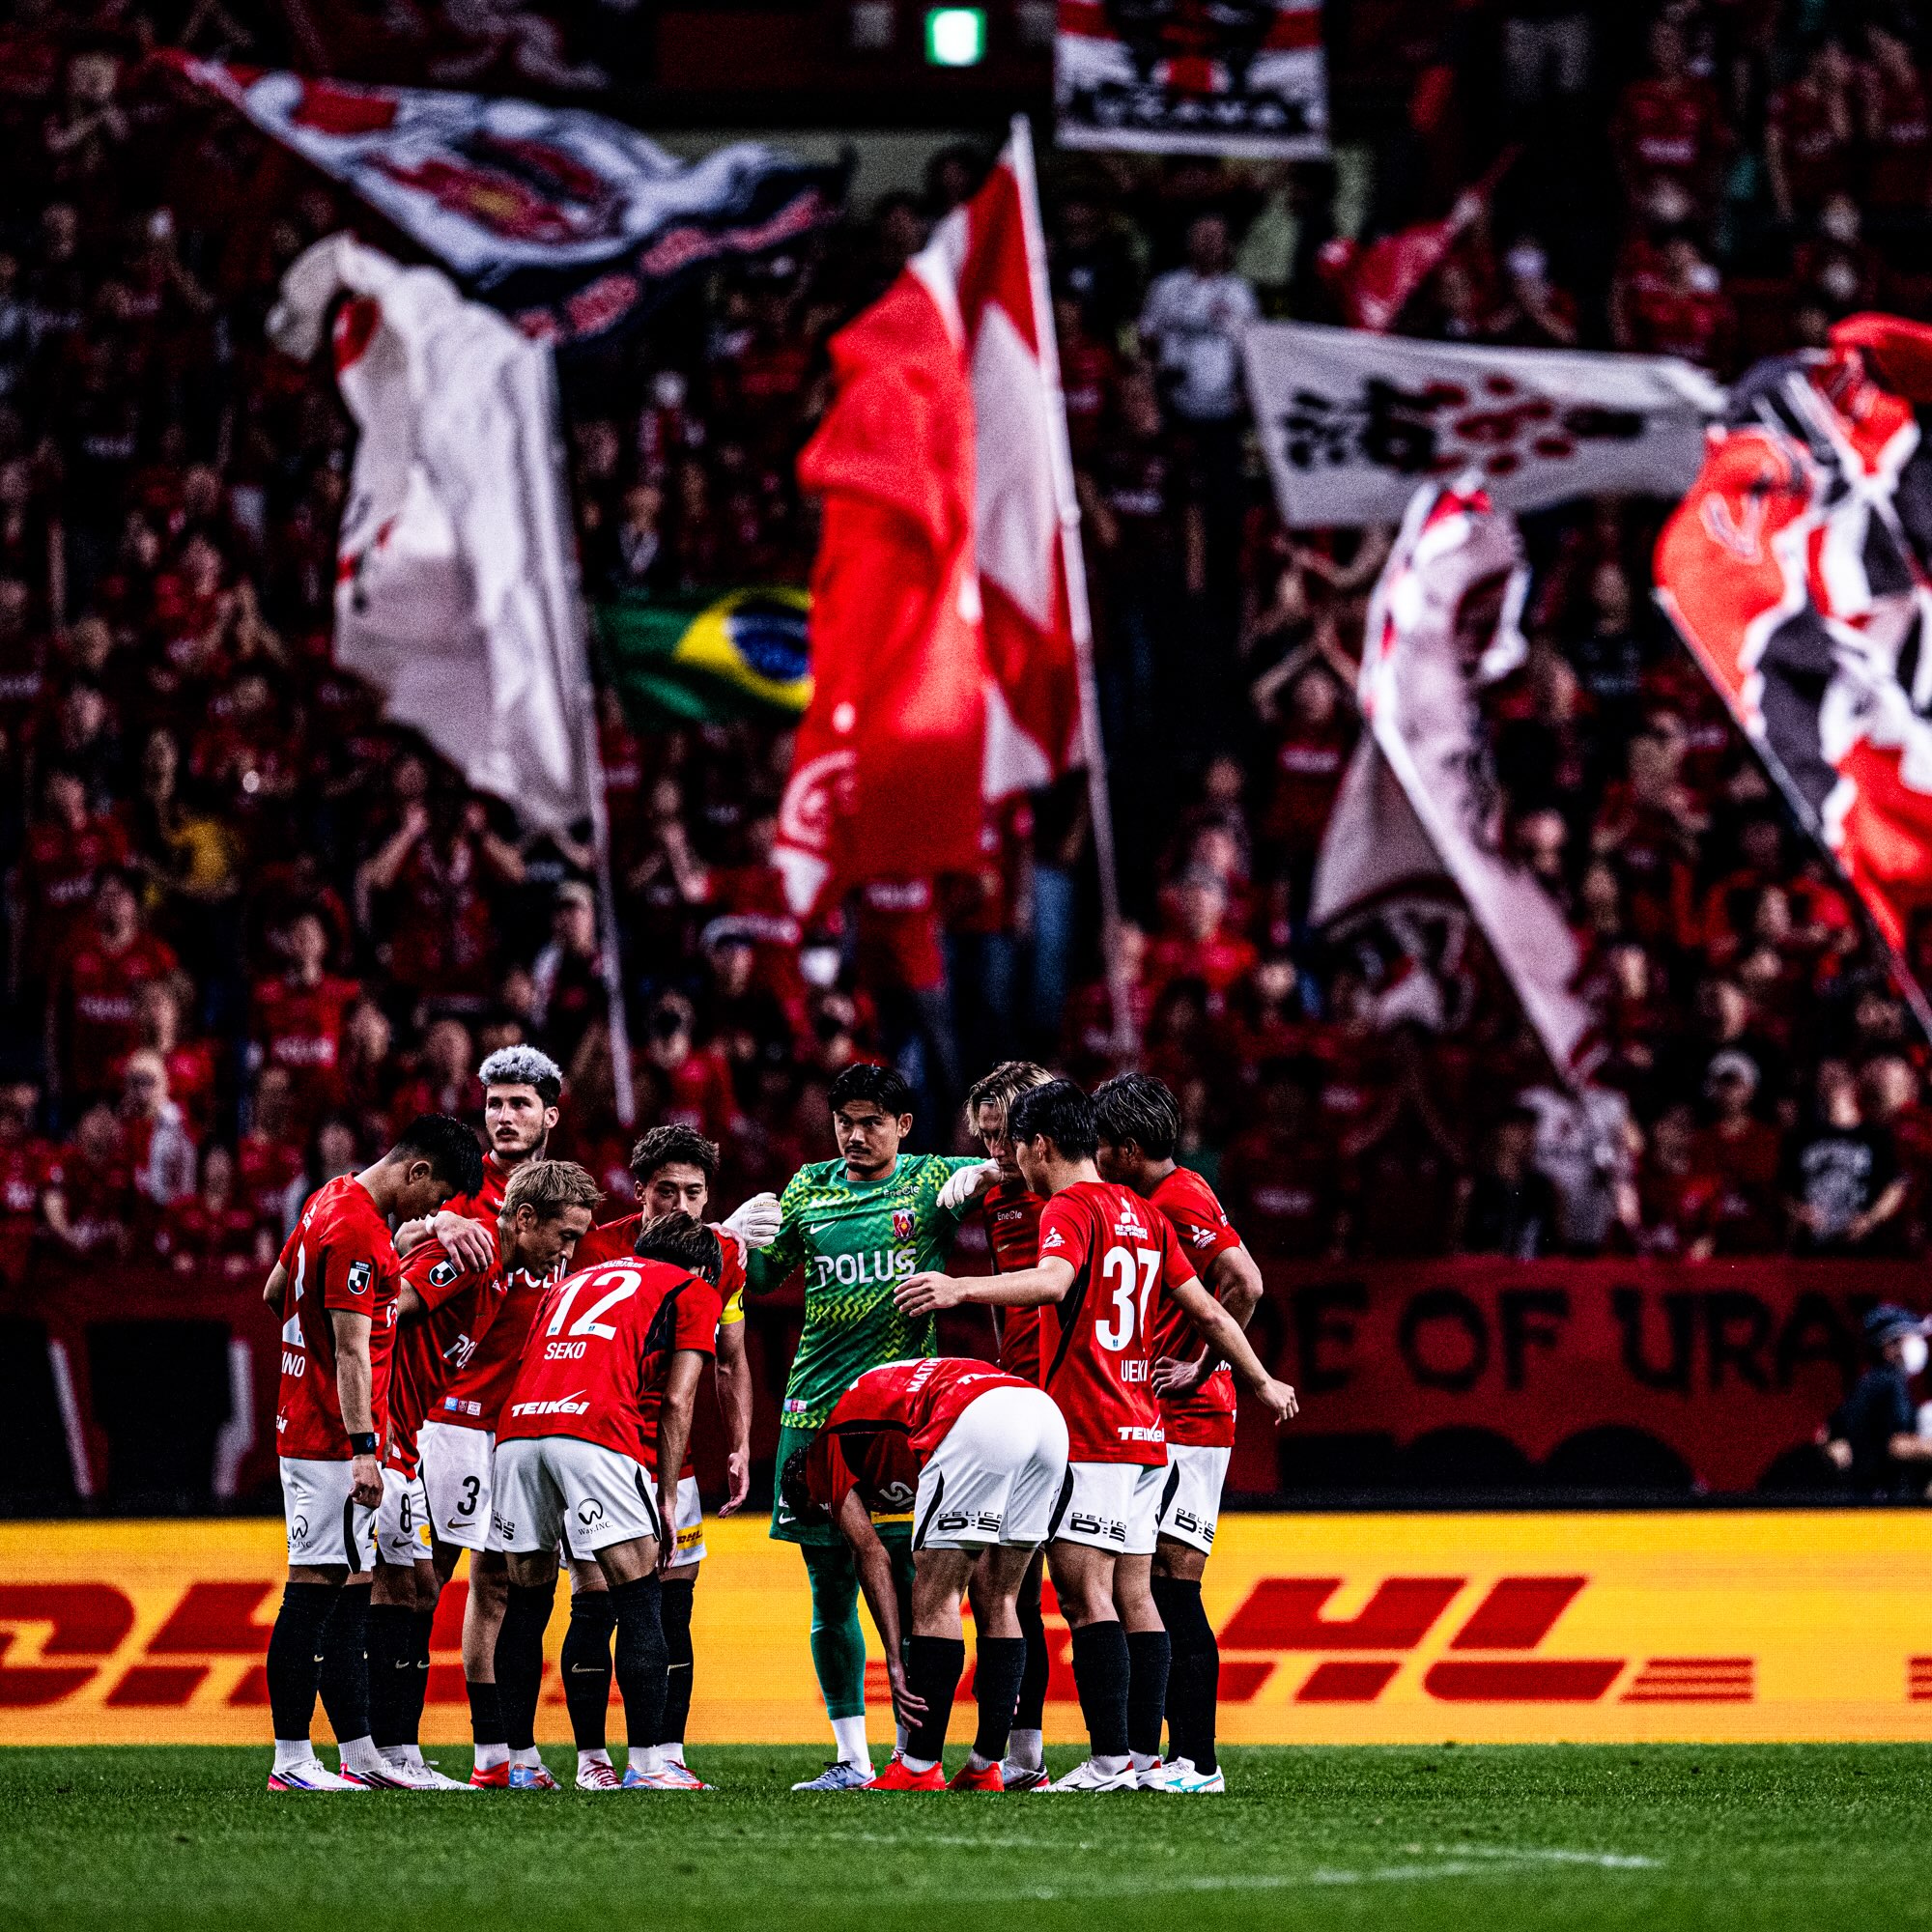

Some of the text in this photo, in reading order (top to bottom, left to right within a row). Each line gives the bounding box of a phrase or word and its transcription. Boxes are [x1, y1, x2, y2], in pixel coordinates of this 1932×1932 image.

[997, 1210, 1022, 1221] EneCle
[813, 1248, 917, 1287] POLUS
[546, 1269, 641, 1340] 12
[1095, 1245, 1161, 1352] 37
[544, 1341, 587, 1360] SEKO
[1397, 1287, 1569, 1391] OF
[1611, 1287, 1870, 1394] URA
[1121, 1360, 1148, 1382] UEKI
[400, 1492, 412, 1533] 8
[457, 1475, 480, 1516] 3
[937, 1517, 1001, 1533] D:5
[1070, 1518, 1126, 1543] D:5
[1175, 1513, 1215, 1544] D:5
